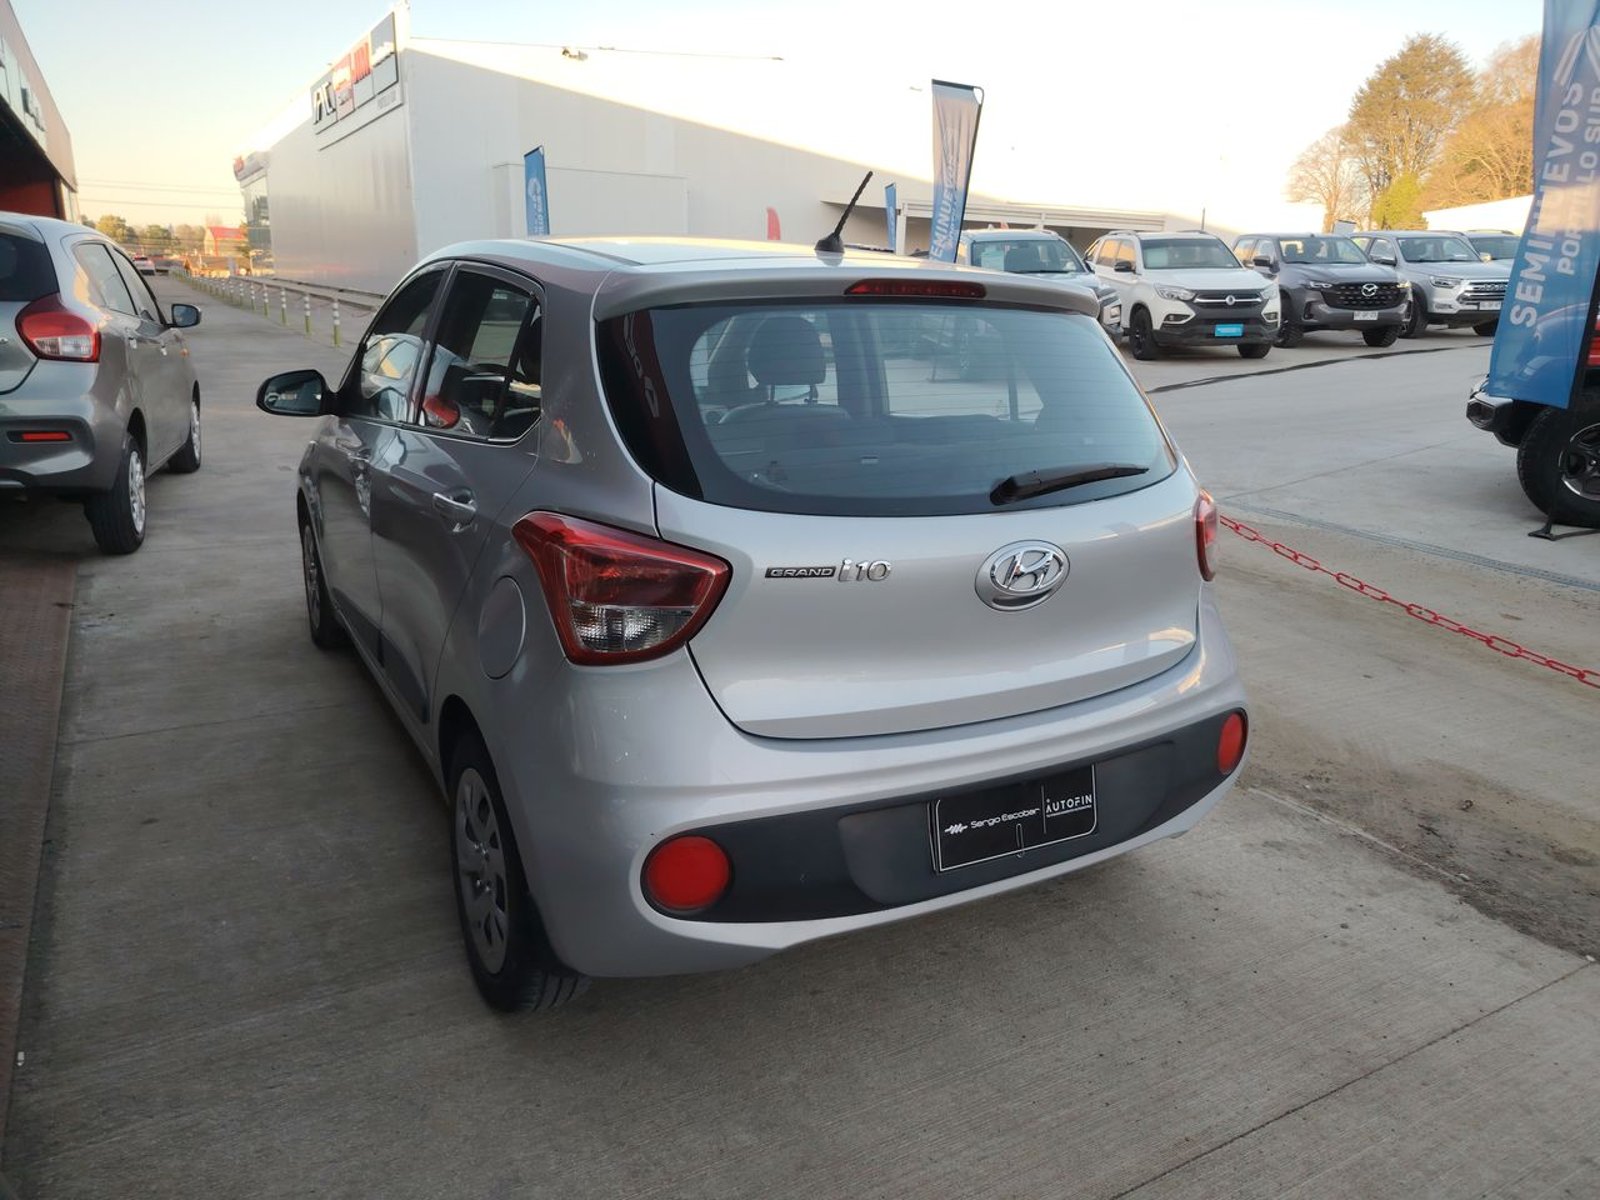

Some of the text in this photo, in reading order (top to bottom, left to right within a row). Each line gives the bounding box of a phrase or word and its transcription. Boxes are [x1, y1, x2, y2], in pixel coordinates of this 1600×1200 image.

[767, 559, 891, 581] GRAND i10
[1046, 794, 1093, 814] AUTOFIN
